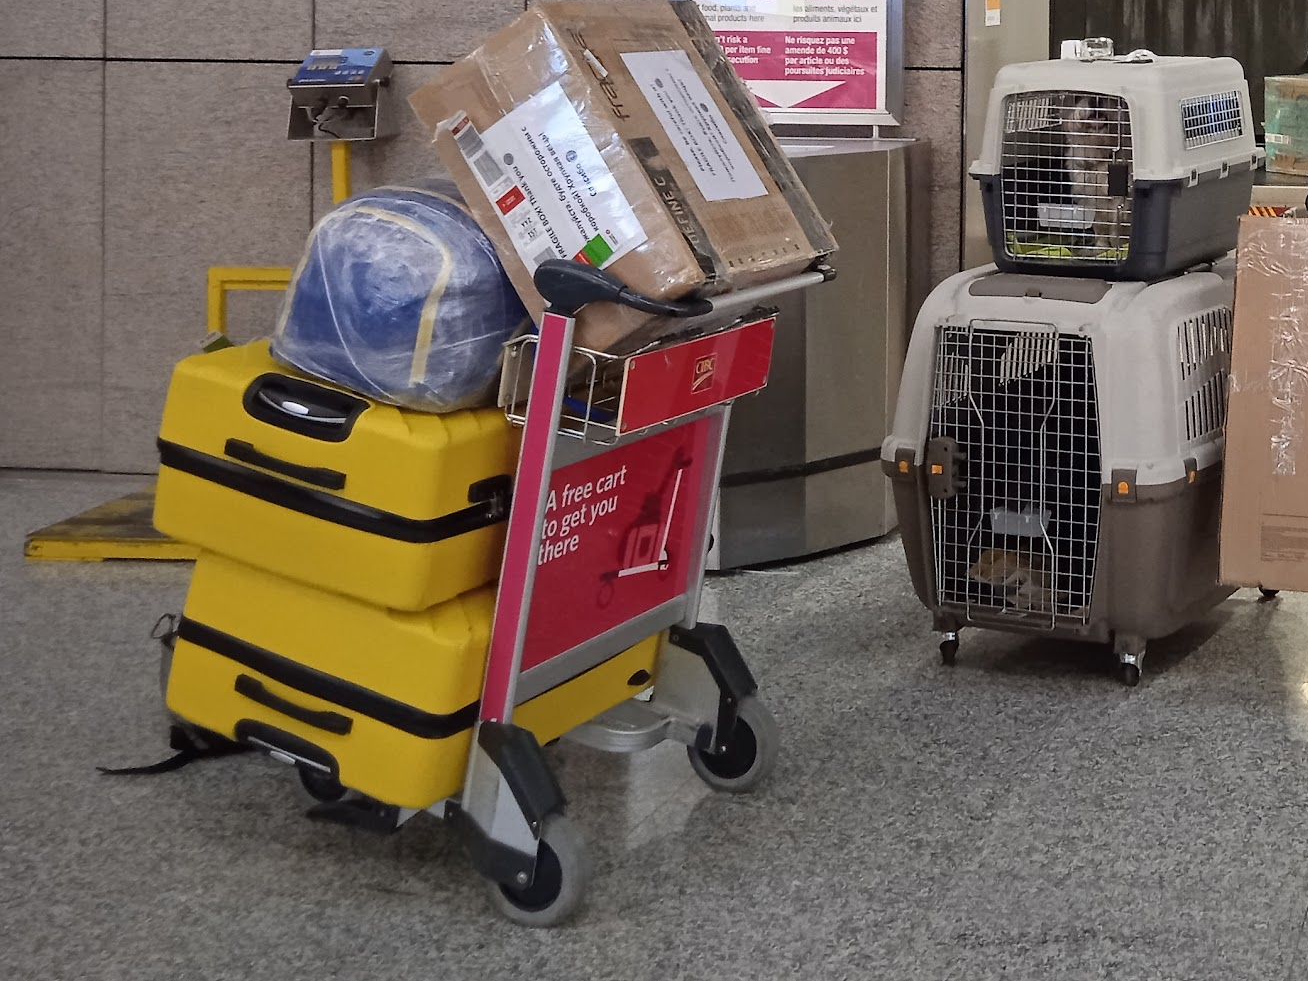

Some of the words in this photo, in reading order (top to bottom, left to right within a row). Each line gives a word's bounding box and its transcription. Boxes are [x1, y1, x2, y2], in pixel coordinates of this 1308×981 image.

[838, 5, 869, 14] végétaux
[718, 15, 747, 23] products
[793, 15, 821, 23] produits
[727, 35, 741, 43] risk
[785, 36, 796, 44] Ne
[796, 36, 825, 45] risquez
[825, 37, 840, 45] pas
[725, 46, 738, 54] per
[739, 45, 755, 54] item
[757, 45, 771, 54] fine
[827, 47, 841, 55] 400
[843, 46, 849, 55] $
[785, 57, 798, 66] par
[799, 56, 823, 65] article
[835, 56, 850, 65] des
[785, 67, 824, 76] poursuites
[825, 67, 865, 76] judiciaires
[523, 130, 554, 178] осторожны
[511, 164, 525, 181] you
[551, 154, 577, 191] Хрупкая
[518, 180, 538, 206] Thank
[532, 205, 550, 227] BOX!
[570, 188, 601, 233] коробкой!
[662, 190, 700, 244] DEFINE
[544, 225, 568, 259] FRAGILE
[696, 357, 716, 374] CIBC
[545, 490, 557, 513] A
[561, 482, 593, 508] free
[596, 465, 627, 494] cart
[541, 518, 558, 540] to
[560, 504, 588, 537] get
[588, 495, 618, 526] you
[537, 534, 580, 566] there
